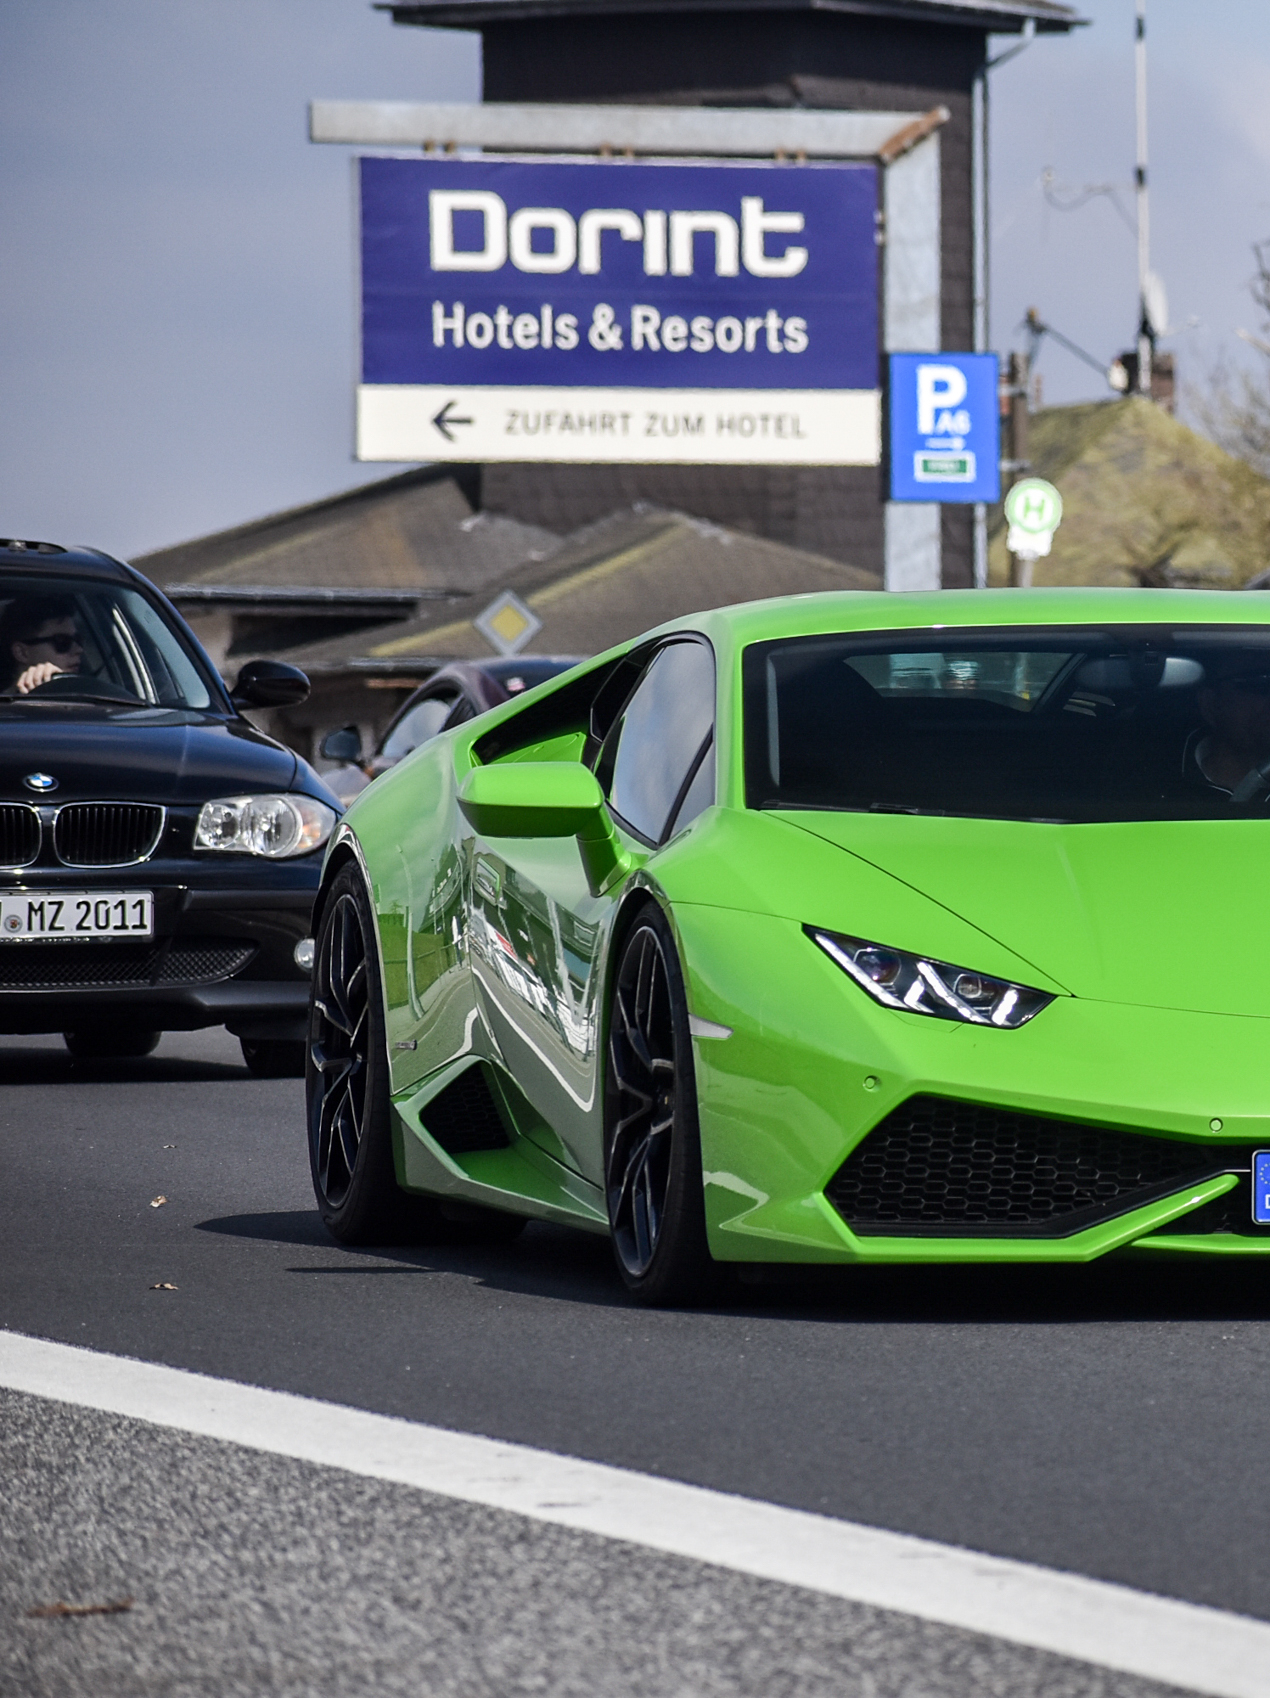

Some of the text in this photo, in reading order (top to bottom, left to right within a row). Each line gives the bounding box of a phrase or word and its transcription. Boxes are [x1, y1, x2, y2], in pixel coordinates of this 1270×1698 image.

[428, 189, 808, 278] Dorint
[431, 300, 809, 355] Hotels & Resorts
[916, 363, 968, 435] P
[504, 409, 807, 441] ZUFAHRT ZUM HOTEL
[1023, 496, 1046, 522] H
[27, 898, 148, 932] MZ 2011
